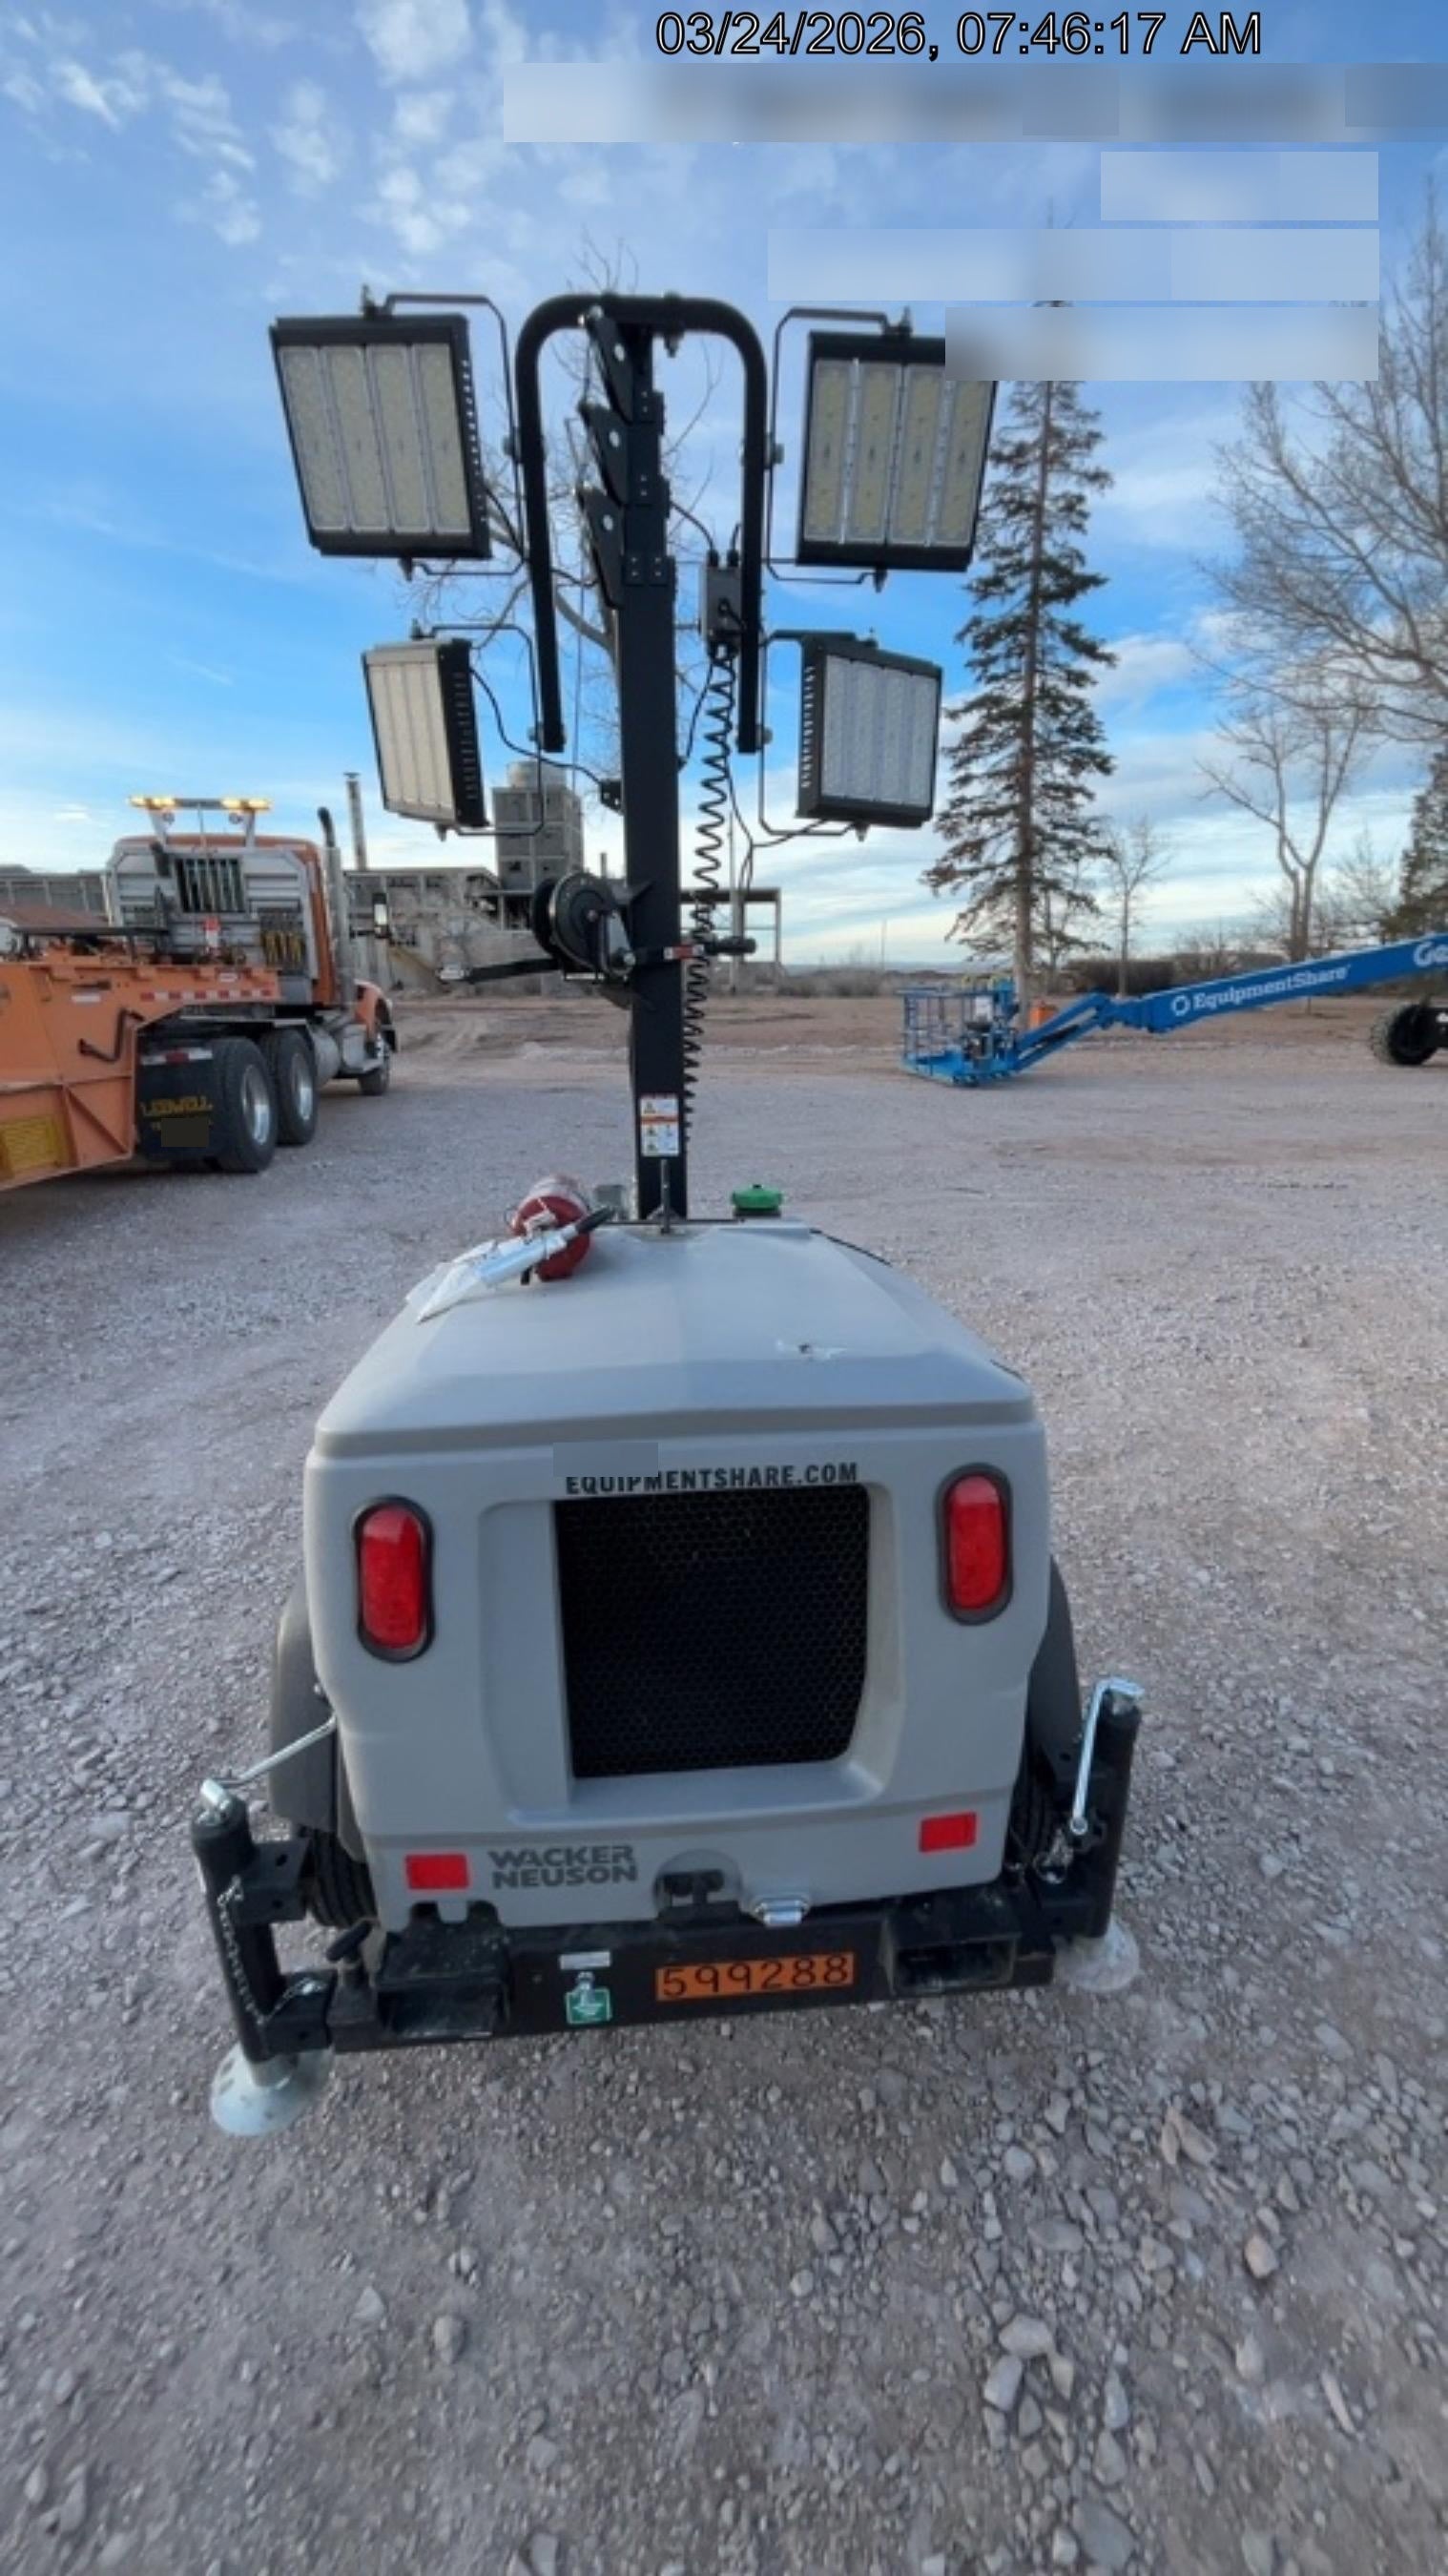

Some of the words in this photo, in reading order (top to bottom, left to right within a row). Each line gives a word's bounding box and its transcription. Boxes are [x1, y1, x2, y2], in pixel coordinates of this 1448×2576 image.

[1192, 966, 1348, 1010] EquipmentShare
[566, 1462, 858, 1495] EQUIPMENTSHARE.COM
[487, 1844, 634, 1868] WACKER
[491, 1865, 638, 1889] NEUSON
[663, 1955, 848, 1998] 599288
